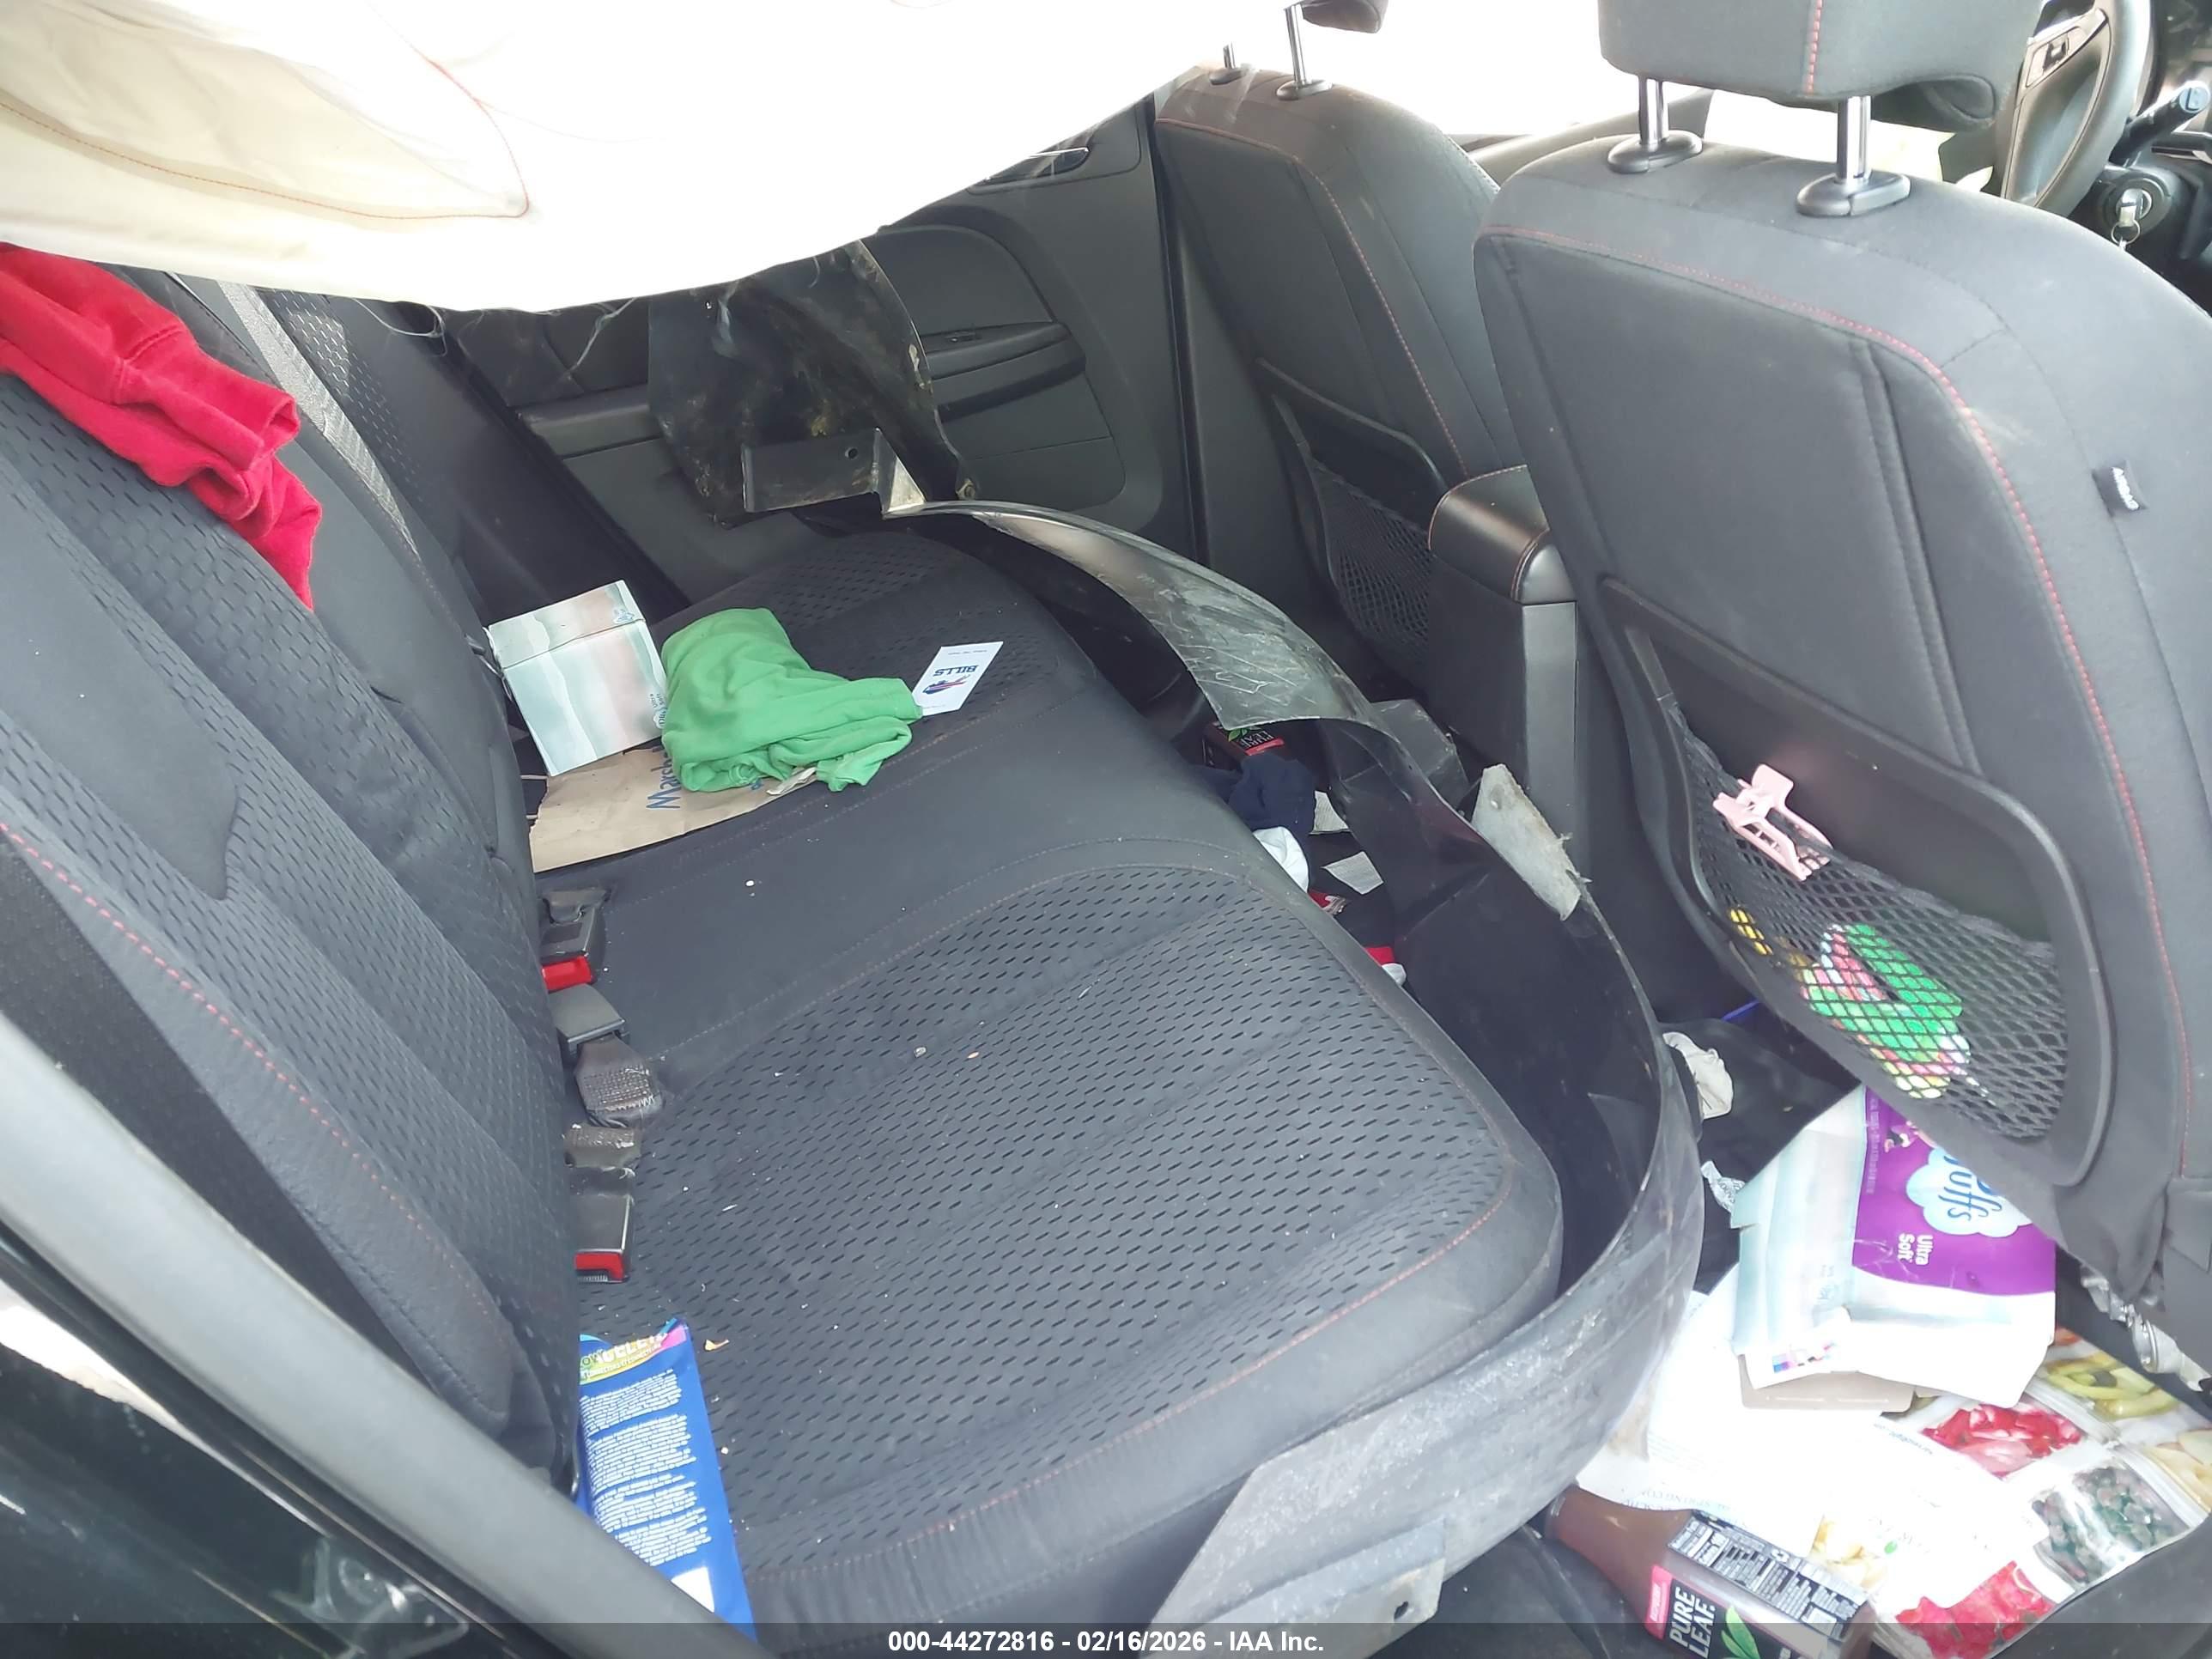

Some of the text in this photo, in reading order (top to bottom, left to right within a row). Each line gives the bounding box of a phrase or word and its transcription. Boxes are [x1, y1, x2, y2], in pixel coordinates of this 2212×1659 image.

[933, 665, 979, 677] BILLS
[1898, 1233, 1916, 1262] Soft
[1914, 1234, 1933, 1266] Ultra
[1669, 1587, 1696, 1648] PURE
